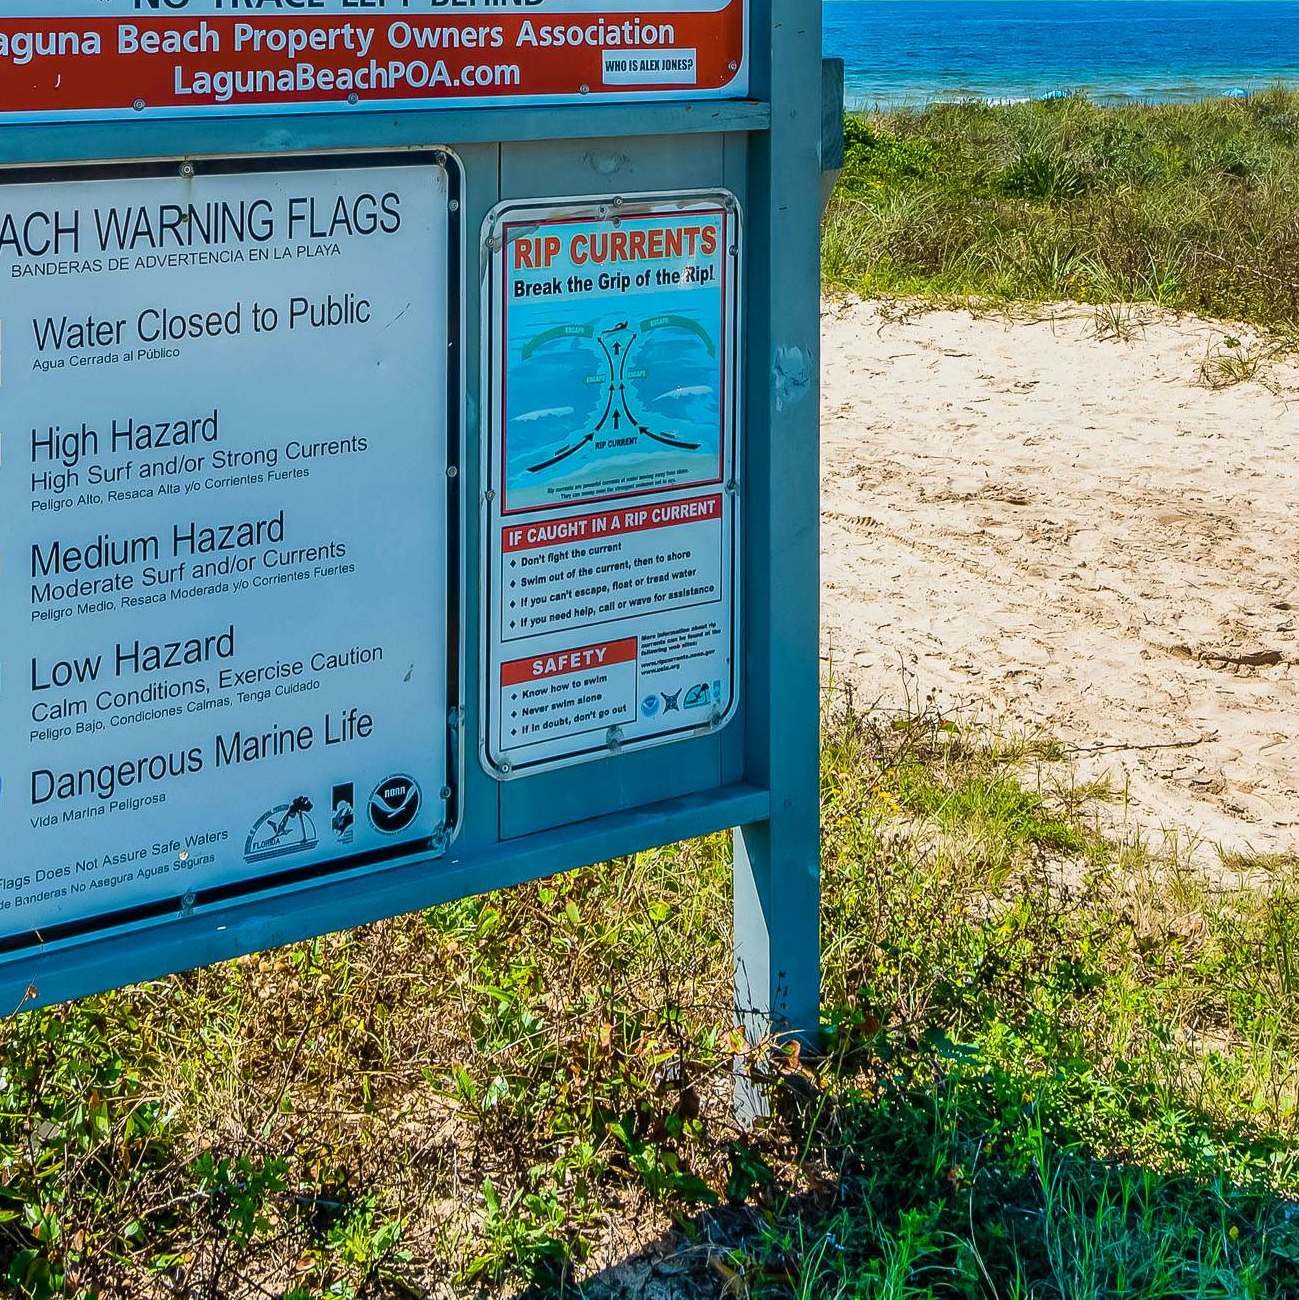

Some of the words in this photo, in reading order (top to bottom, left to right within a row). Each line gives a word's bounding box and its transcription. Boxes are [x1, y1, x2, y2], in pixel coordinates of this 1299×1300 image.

[117, 21, 219, 53] Beach
[234, 23, 374, 58] Property
[387, 21, 503, 48] Owners
[515, 17, 674, 46] Association
[174, 59, 519, 101] LagunaBeachPOA.com
[605, 60, 627, 72] WHO
[629, 60, 638, 72] IS
[640, 59, 660, 71] ALEX
[662, 58, 693, 71] JONES?
[93, 199, 273, 251] WARNING
[288, 192, 400, 239] FLAGS
[11, 258, 102, 277] BANDERAS
[108, 257, 129, 271] DE
[134, 249, 244, 269] ADVERTENCIA
[248, 247, 268, 261] EN
[274, 246, 292, 259] LA
[296, 243, 340, 257] PLAYA
[514, 235, 560, 269] RIP
[570, 225, 716, 264] CURRENTS
[514, 277, 562, 297] Break
[566, 275, 593, 292] the
[597, 271, 630, 292] Grip
[635, 269, 651, 286] of
[655, 268, 680, 285] the
[685, 264, 715, 285] Rip!
[32, 315, 126, 351] Water
[137, 301, 240, 341] Closed
[251, 302, 277, 332] to
[289, 292, 370, 329] Public
[32, 359, 64, 372] Agua
[69, 352, 118, 366] Cerrada
[123, 350, 133, 361] al
[137, 347, 180, 360] Público
[31, 423, 97, 467] High
[111, 408, 217, 452] Hazard
[594, 440, 606, 449] RIP
[607, 436, 637, 447] CURRENT
[31, 468, 78, 493] High
[87, 460, 132, 484] Surf
[138, 454, 205, 478] and/or
[212, 448, 277, 468] Strong
[285, 435, 367, 459] Currents
[31, 498, 73, 511] Peligro
[107, 489, 153, 501] Resaca
[157, 483, 180, 495] Alta
[184, 480, 200, 495] y/o
[204, 473, 263, 489] Corrientes
[267, 468, 309, 481] Fuertes
[31, 533, 158, 577] Medium
[173, 509, 283, 556] Hazard
[509, 530, 522, 546] IF
[527, 520, 587, 543] CAUGHT
[592, 516, 606, 532] IN
[610, 515, 620, 529] A
[625, 510, 647, 527] RIP
[651, 499, 715, 522] CURRENT
[31, 572, 133, 603] Moderate
[141, 562, 185, 586] Surf
[192, 554, 256, 578] and/or
[263, 540, 345, 567] Currents
[520, 575, 546, 587] Swim
[548, 571, 564, 581] out
[566, 568, 576, 578] of
[578, 566, 593, 576] the
[595, 559, 631, 573] current,
[633, 557, 653, 567] then
[655, 554, 664, 563] to
[666, 550, 690, 561] shore
[547, 549, 568, 563] fight
[571, 548, 586, 558] the
[588, 541, 621, 555] current
[31, 655, 101, 691] Low
[115, 624, 233, 676] Hazard
[532, 647, 606, 675] SAFETY
[31, 698, 86, 722] Calm
[95, 678, 209, 710] Conditions,
[219, 660, 303, 688] Exercise
[310, 646, 382, 671] Caution
[522, 687, 548, 699] Know
[550, 682, 569, 693] how
[571, 680, 581, 688] to
[583, 675, 607, 685] swim
[522, 704, 548, 716] Never
[551, 699, 574, 710] swim
[577, 693, 602, 704] alone
[31, 747, 202, 804] Dangerous
[215, 723, 312, 767] Marine
[325, 707, 372, 745] Life
[29, 814, 58, 828] Vida
[62, 805, 104, 822] Marina
[109, 793, 165, 812] Peligrosa
[35, 866, 70, 882] Does
[75, 857, 98, 873] Not
[101, 848, 147, 867] Assure
[151, 839, 180, 858] Safe
[182, 830, 228, 852] Waters
